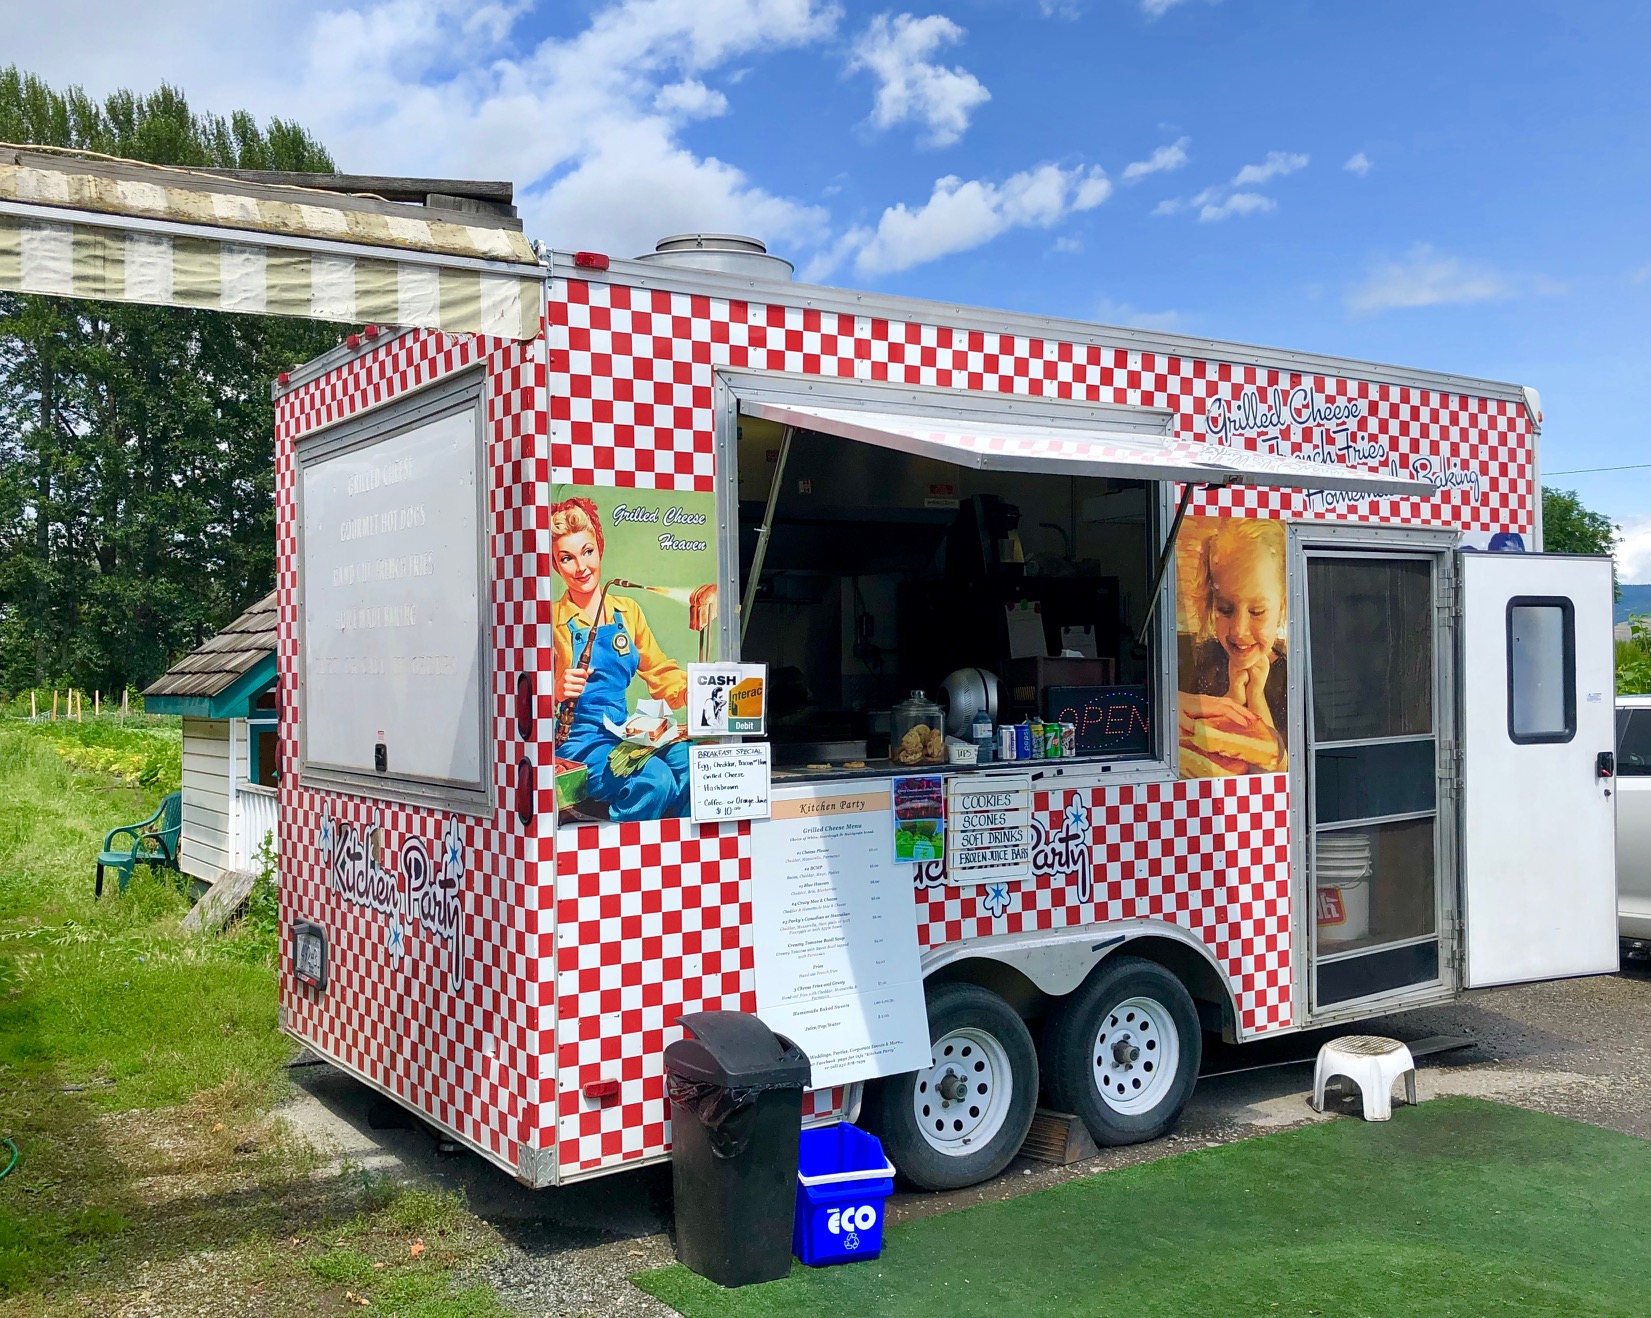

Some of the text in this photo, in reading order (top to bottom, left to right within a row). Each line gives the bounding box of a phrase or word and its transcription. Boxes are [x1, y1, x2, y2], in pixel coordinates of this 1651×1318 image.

[1206, 387, 1361, 442] Grilled Cheese
[1332, 427, 1386, 464] Fries
[1412, 456, 1480, 503] Baking
[340, 502, 426, 542] GOURMET HOT DOGS
[612, 503, 707, 527] Grilled Cheese
[658, 533, 707, 551] Heaven
[697, 675, 737, 686] CASH
[728, 686, 763, 702] Interac
[735, 721, 754, 731] Debit
[1058, 705, 1150, 736] OPEN
[697, 749, 733, 759] BREAKFAST
[956, 749, 972, 758] TIPS
[799, 800, 866, 814] Kitchen Party
[962, 794, 1011, 810] COOKIES
[962, 813, 1006, 829] SCONES
[961, 829, 1024, 847] SOFT DRINKS
[959, 847, 1029, 865] FROZEN JUICE BARS
[328, 822, 462, 986] Kitchen Party
